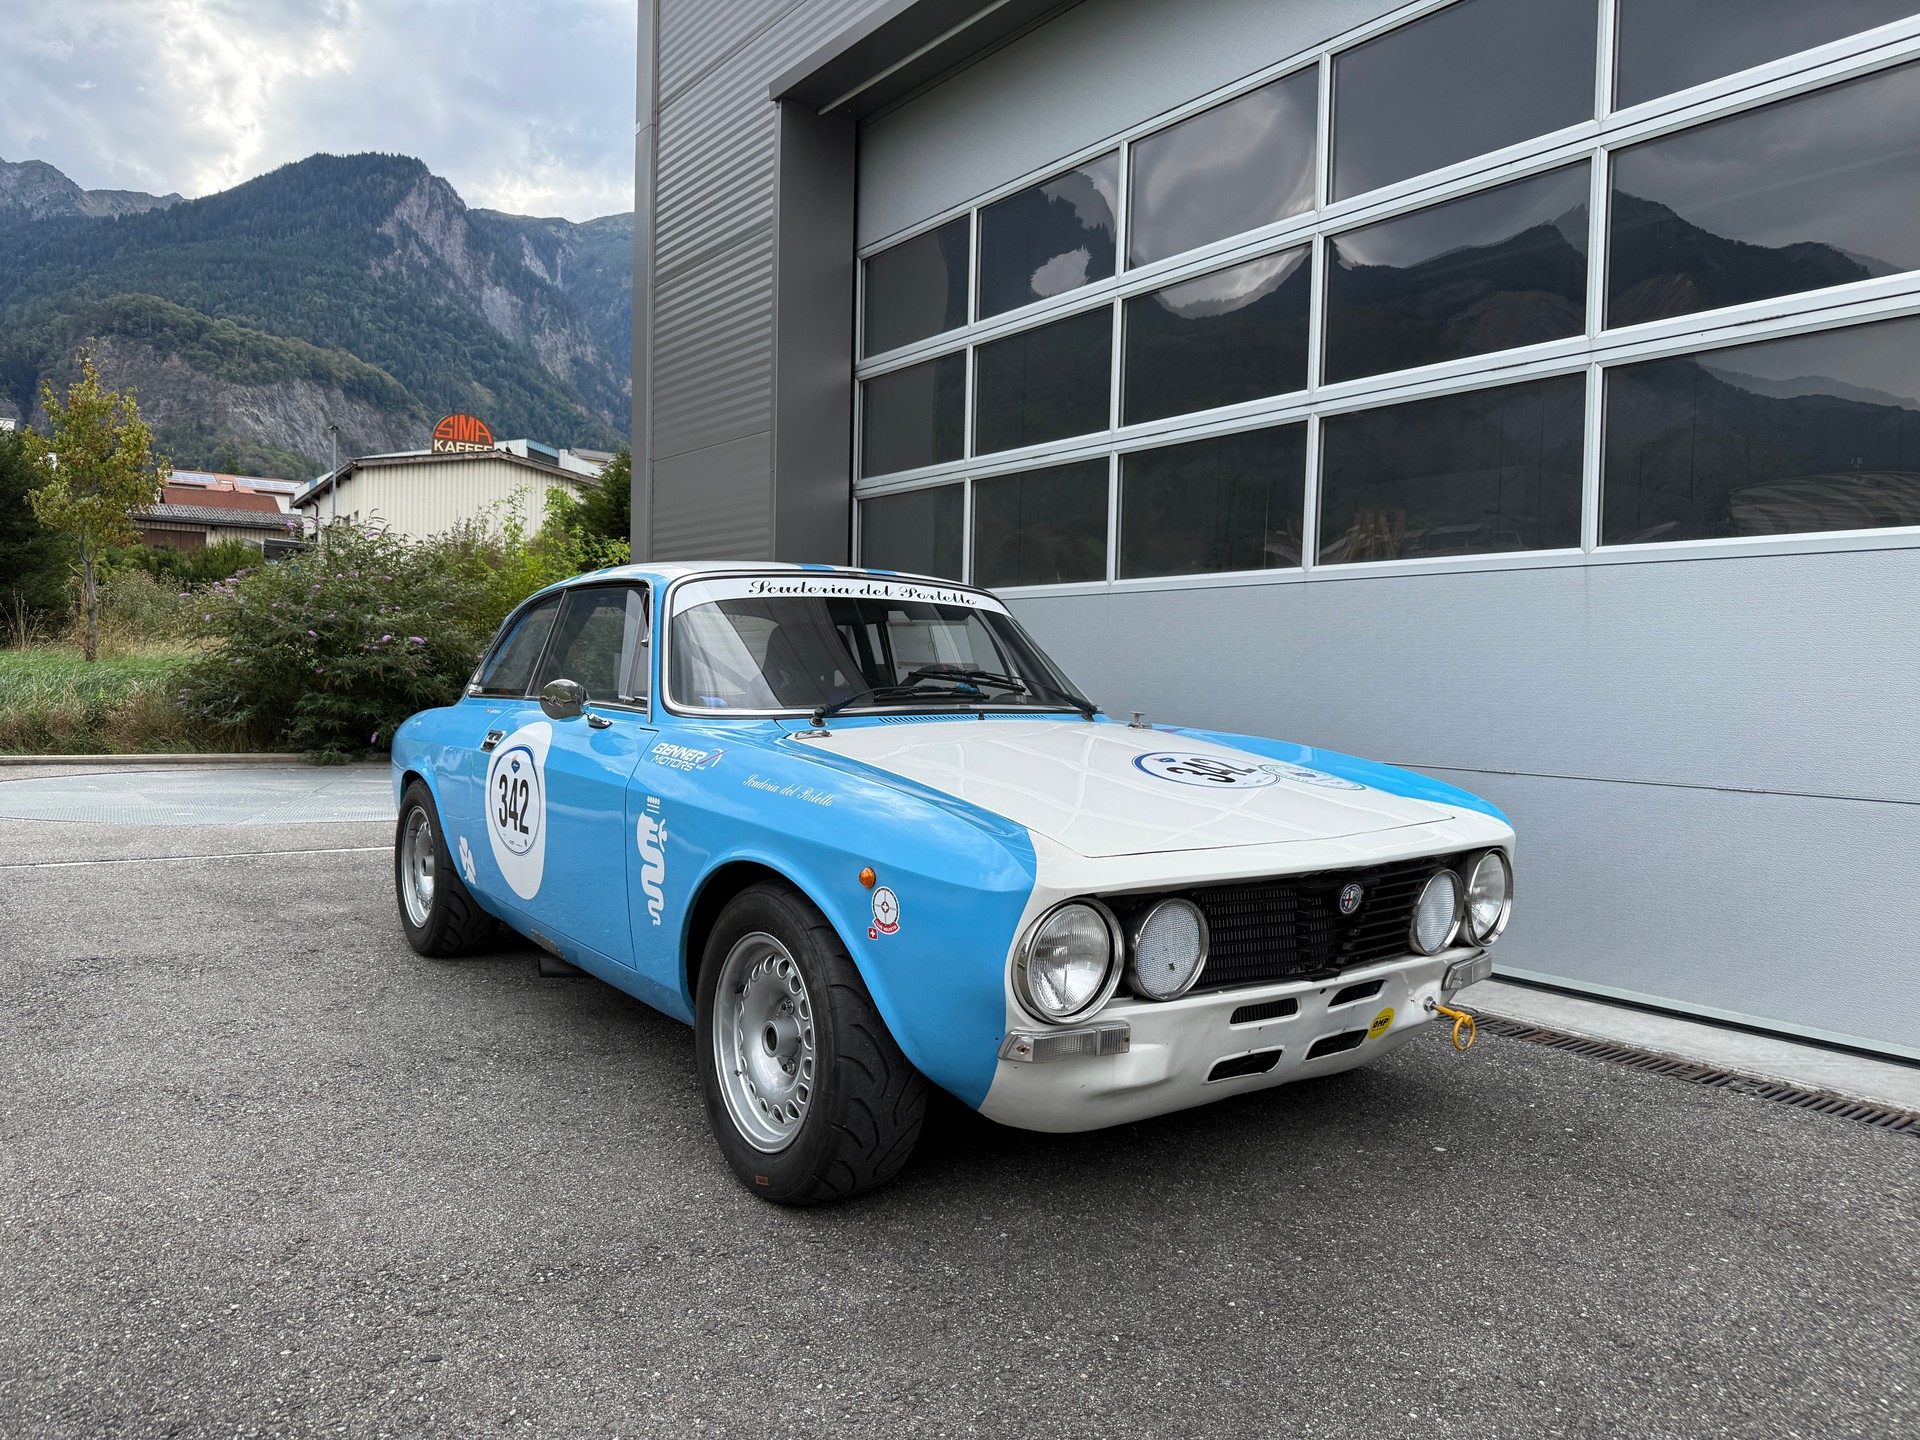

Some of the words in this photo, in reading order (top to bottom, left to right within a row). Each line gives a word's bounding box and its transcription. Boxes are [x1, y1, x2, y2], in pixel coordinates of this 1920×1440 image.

[435, 414, 493, 444] SIMA
[748, 580, 855, 595] Scuderia
[859, 583, 894, 597] del
[899, 586, 977, 606] Portello
[651, 742, 708, 763] BENNER
[651, 754, 696, 771] MOTORS
[1166, 757, 1258, 784] 342
[779, 783, 802, 797] del
[498, 773, 530, 835] 342
